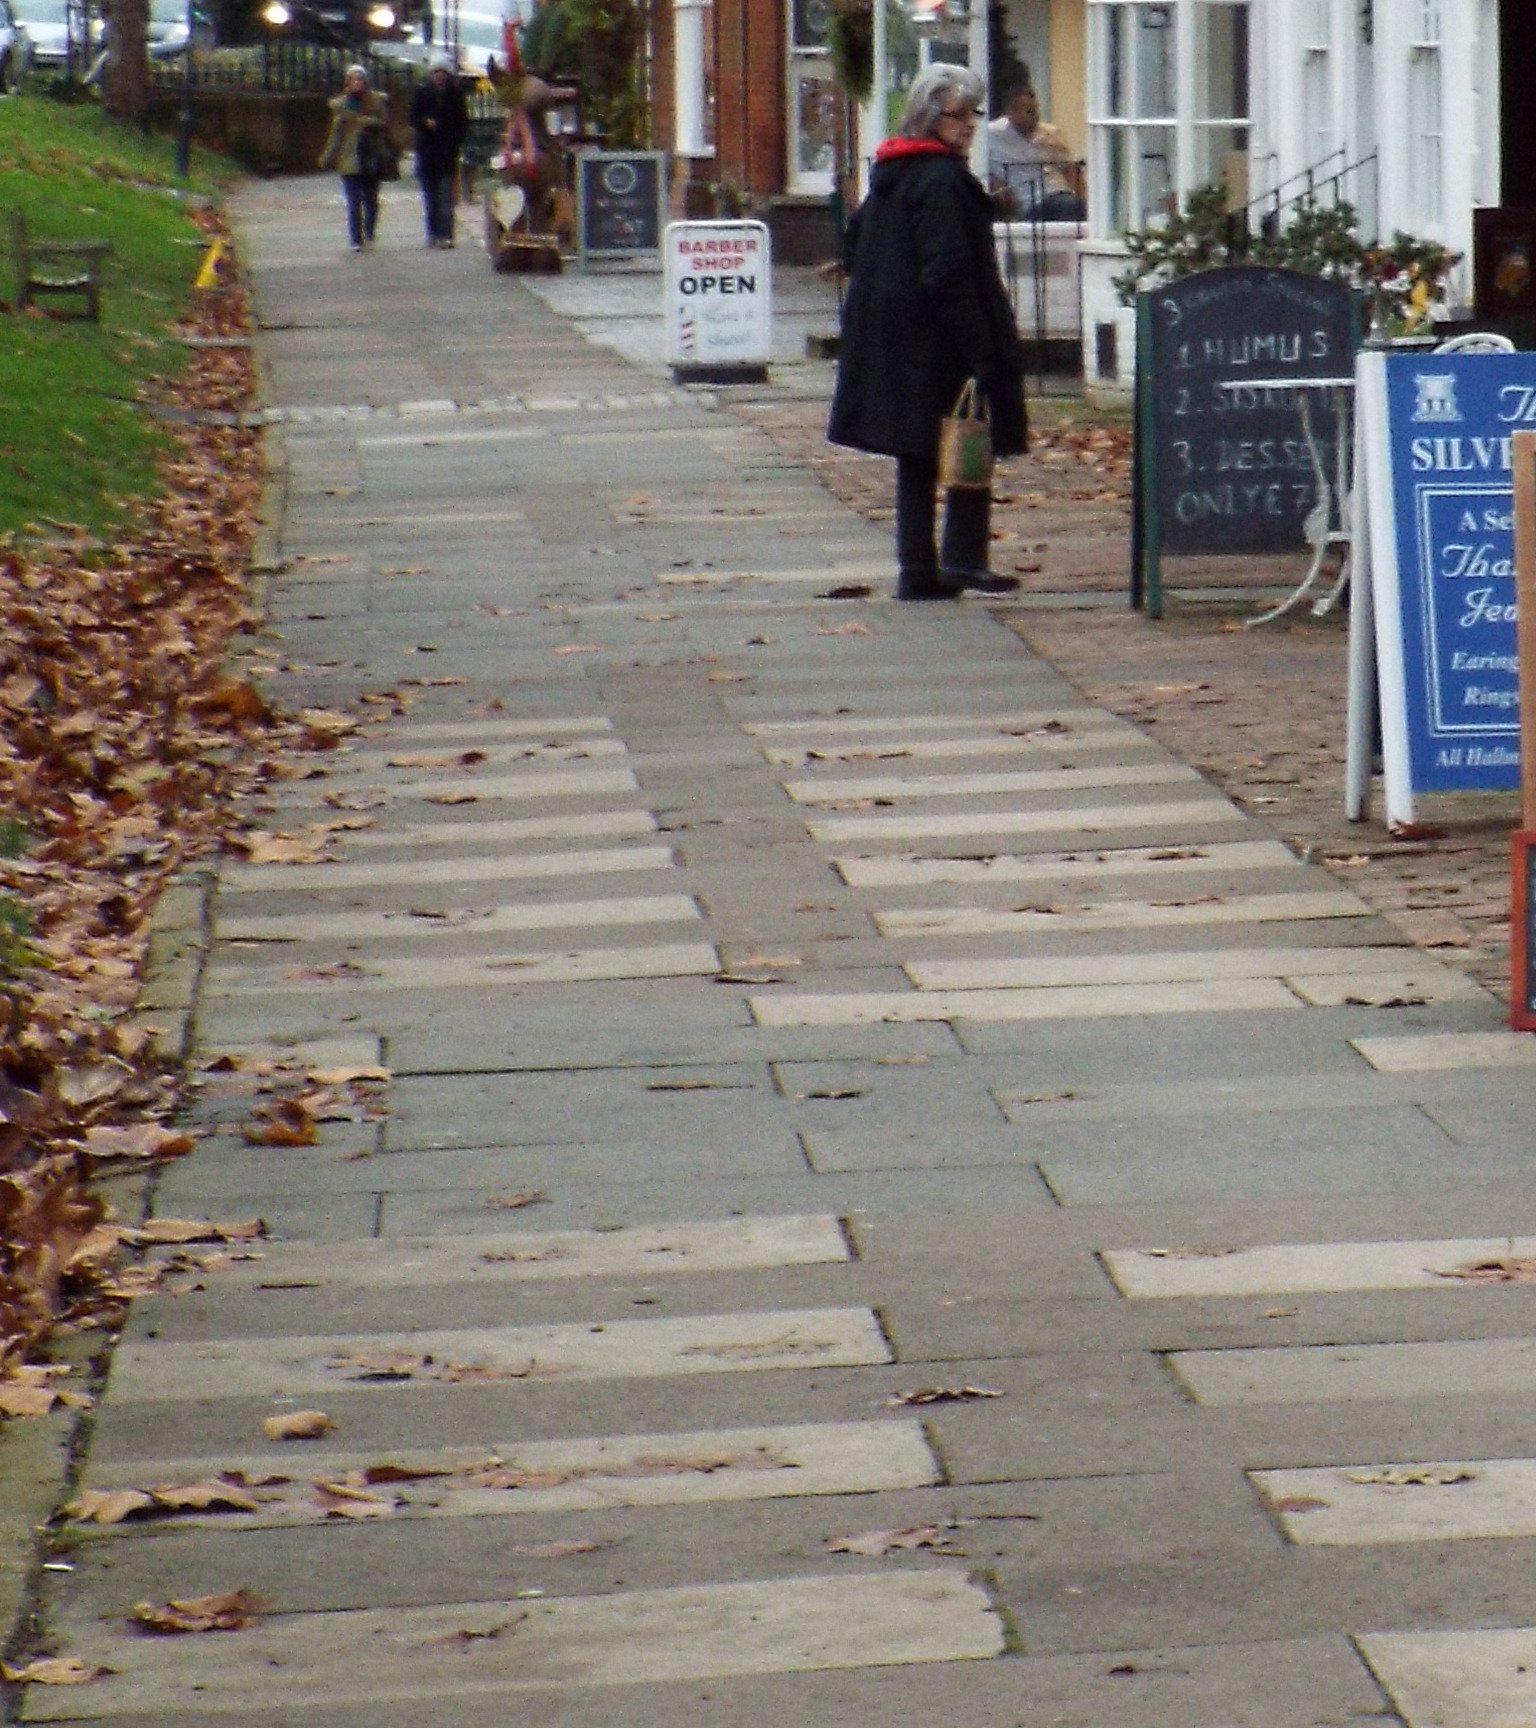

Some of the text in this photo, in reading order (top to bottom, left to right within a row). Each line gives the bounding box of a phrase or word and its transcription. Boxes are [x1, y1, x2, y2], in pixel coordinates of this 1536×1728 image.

[679, 240, 758, 254] BARBER
[692, 258, 745, 270] SHOP
[679, 276, 756, 294] OPEN
[1459, 510, 1479, 532] A
[1441, 544, 1517, 578] Tha
